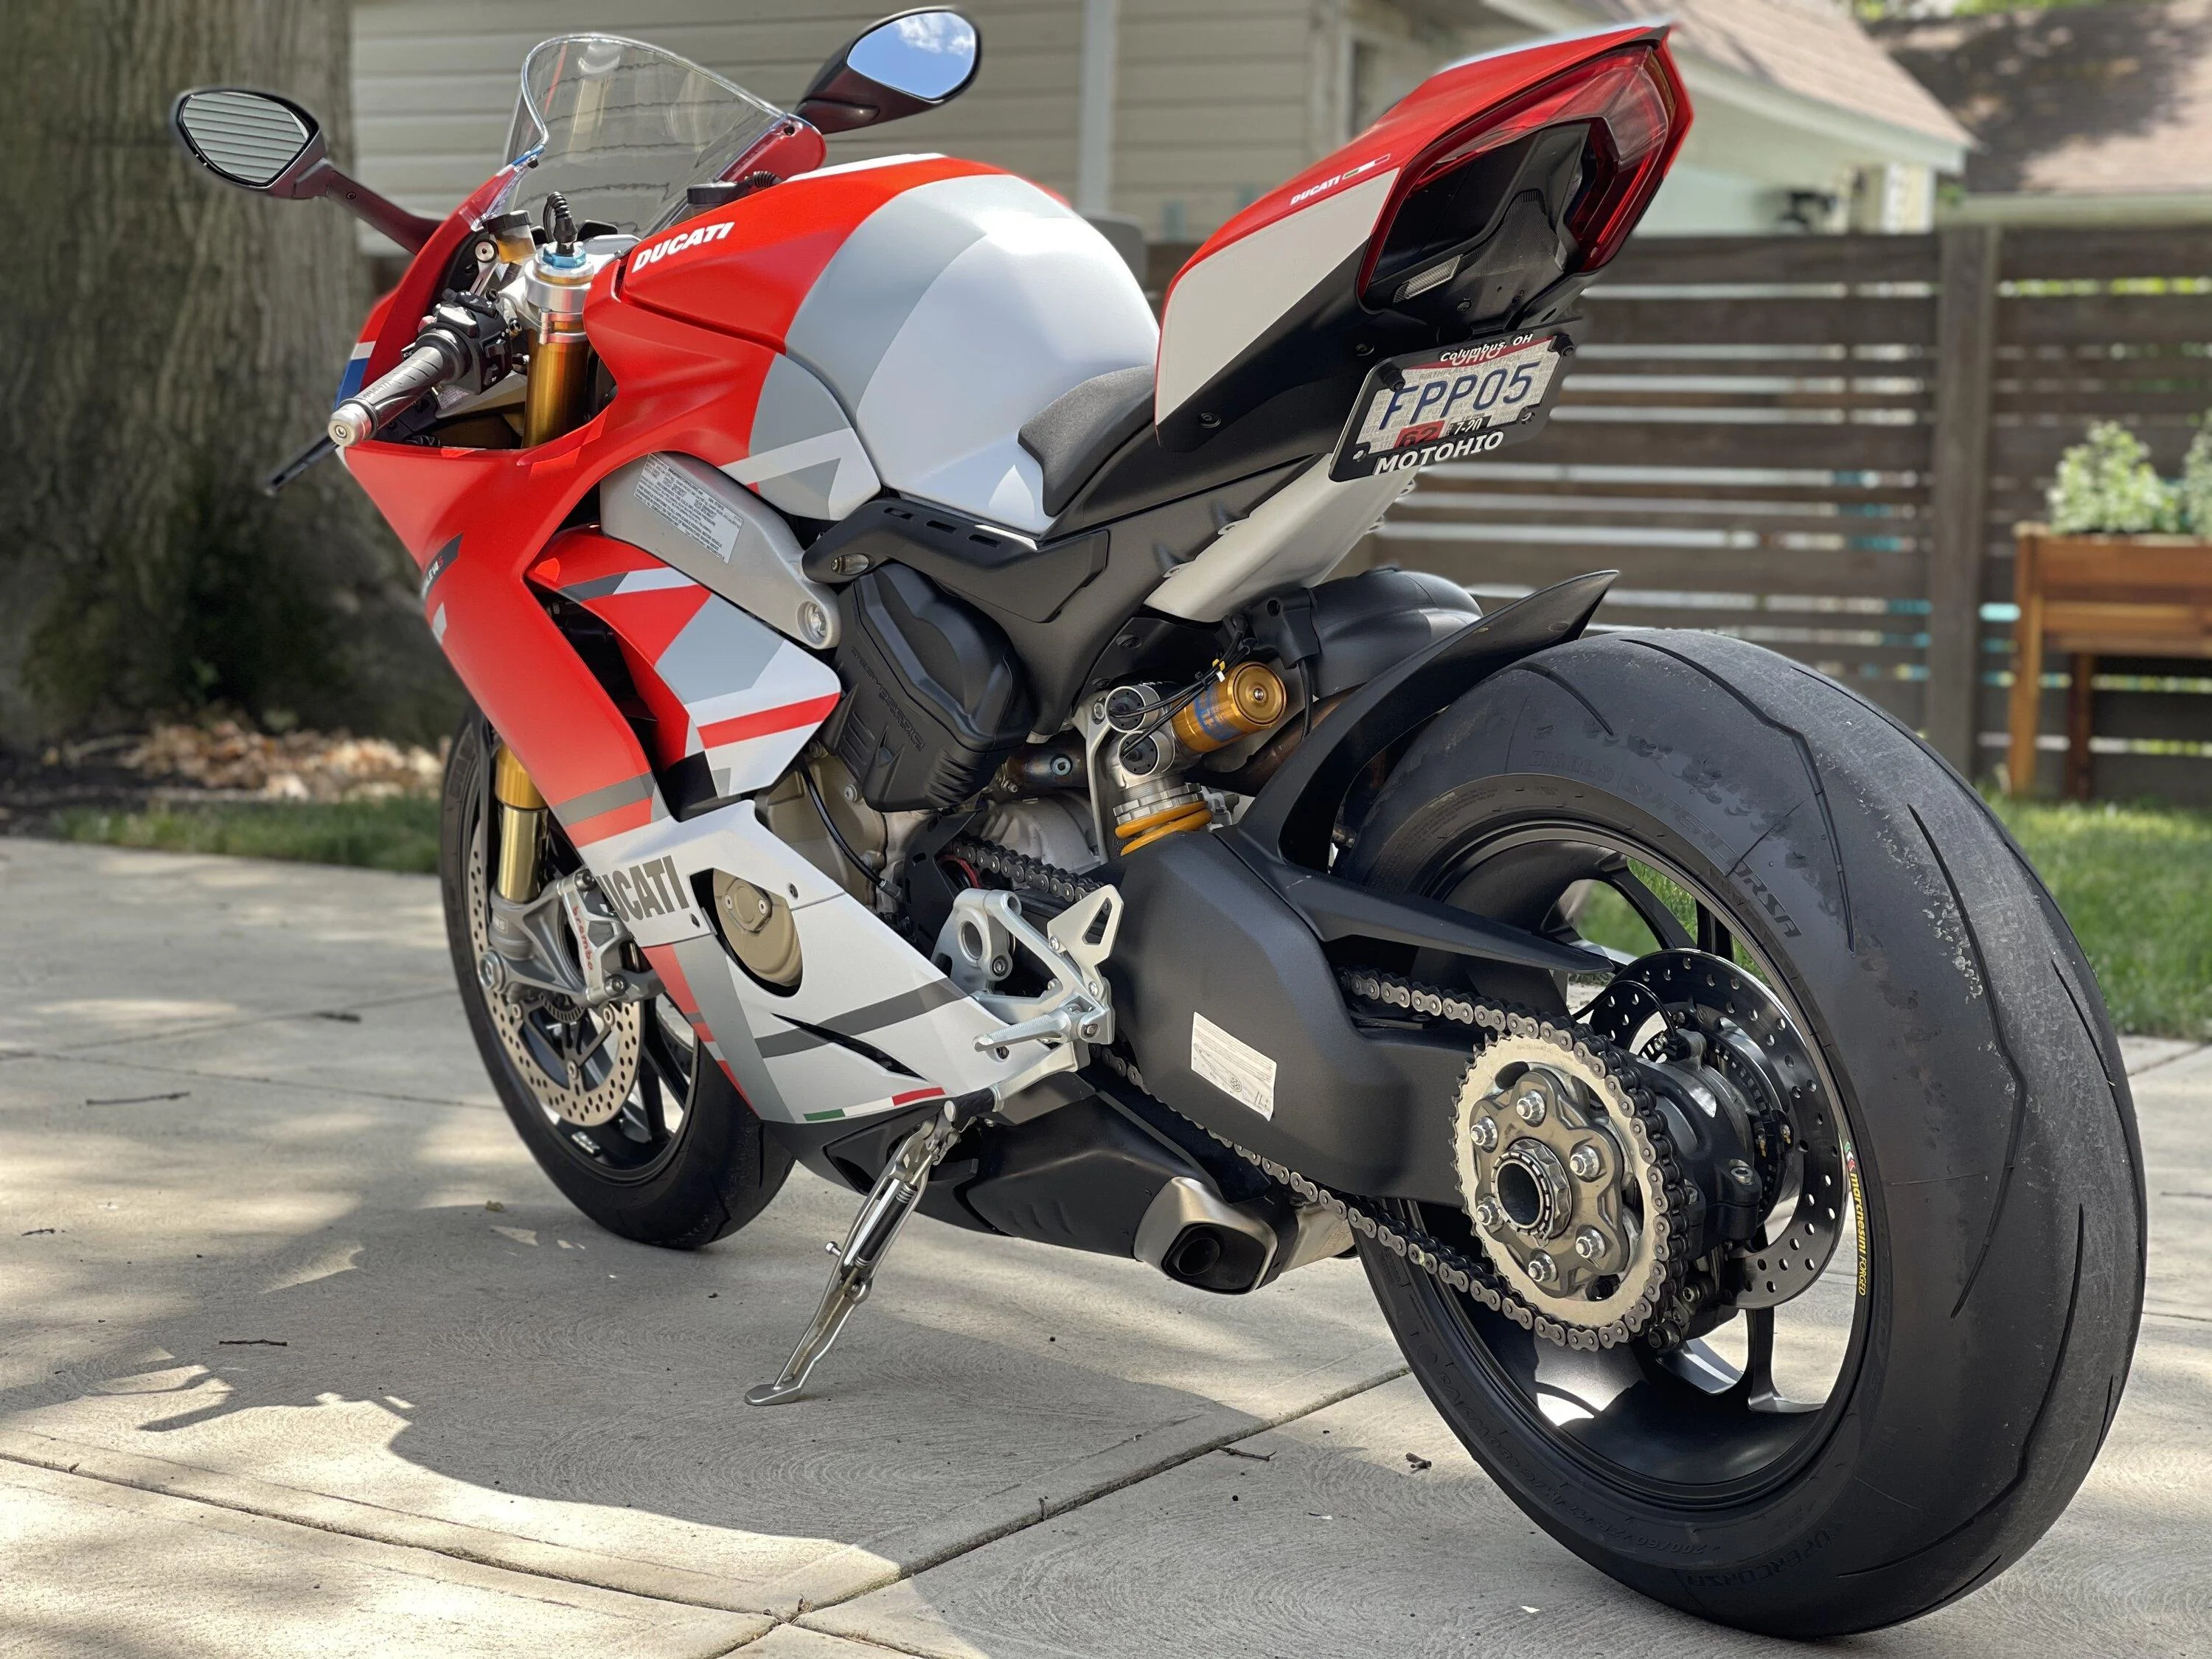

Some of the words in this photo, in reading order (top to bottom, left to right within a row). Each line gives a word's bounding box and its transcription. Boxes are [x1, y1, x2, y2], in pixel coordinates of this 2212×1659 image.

[1290, 175, 1341, 206] DUCATI
[631, 221, 736, 274] DUCATI
[1440, 341, 1507, 362] Columbus,
[1512, 333, 1534, 346] OH
[1378, 361, 1542, 431] FPP05
[1399, 426, 1438, 447] 62
[1454, 417, 1484, 435] 7-20
[1372, 431, 1504, 476] MOTOHIO
[595, 855, 690, 922] UCATI
[1858, 1255, 1868, 1296] FORGED
